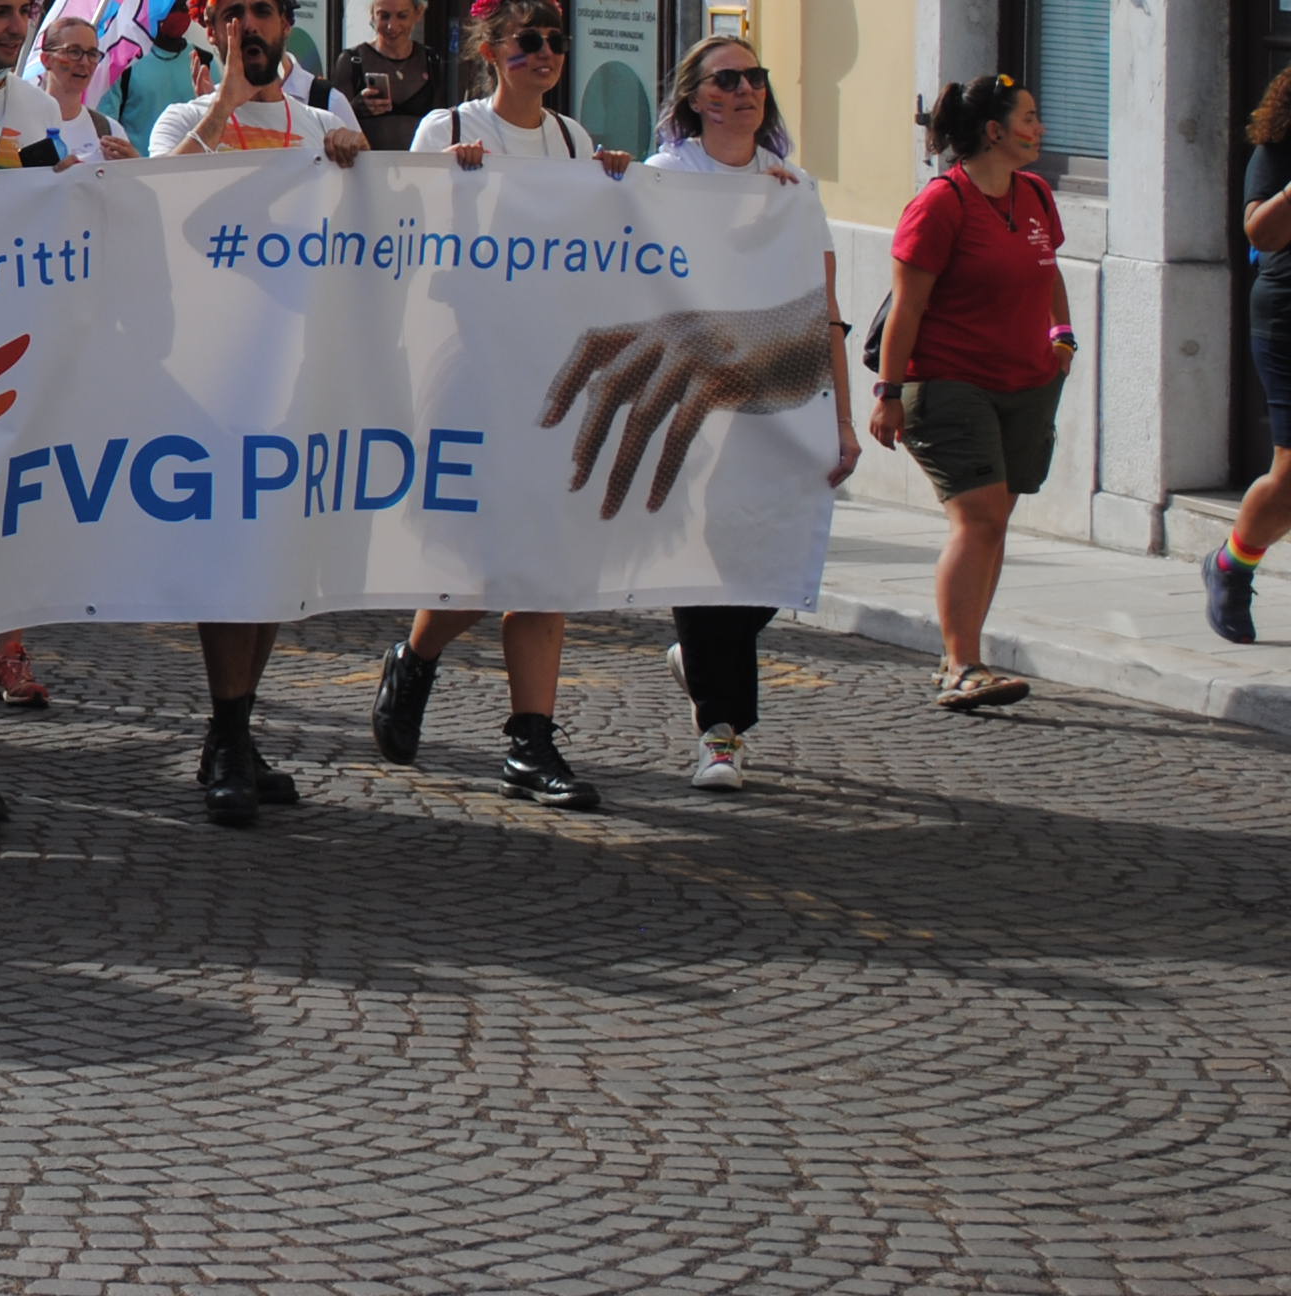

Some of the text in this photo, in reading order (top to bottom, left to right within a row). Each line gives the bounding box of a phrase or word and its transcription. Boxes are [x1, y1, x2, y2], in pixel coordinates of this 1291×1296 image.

[205, 220, 689, 282] #odmejimopravice
[1, 428, 485, 537] FVG PRIDE
